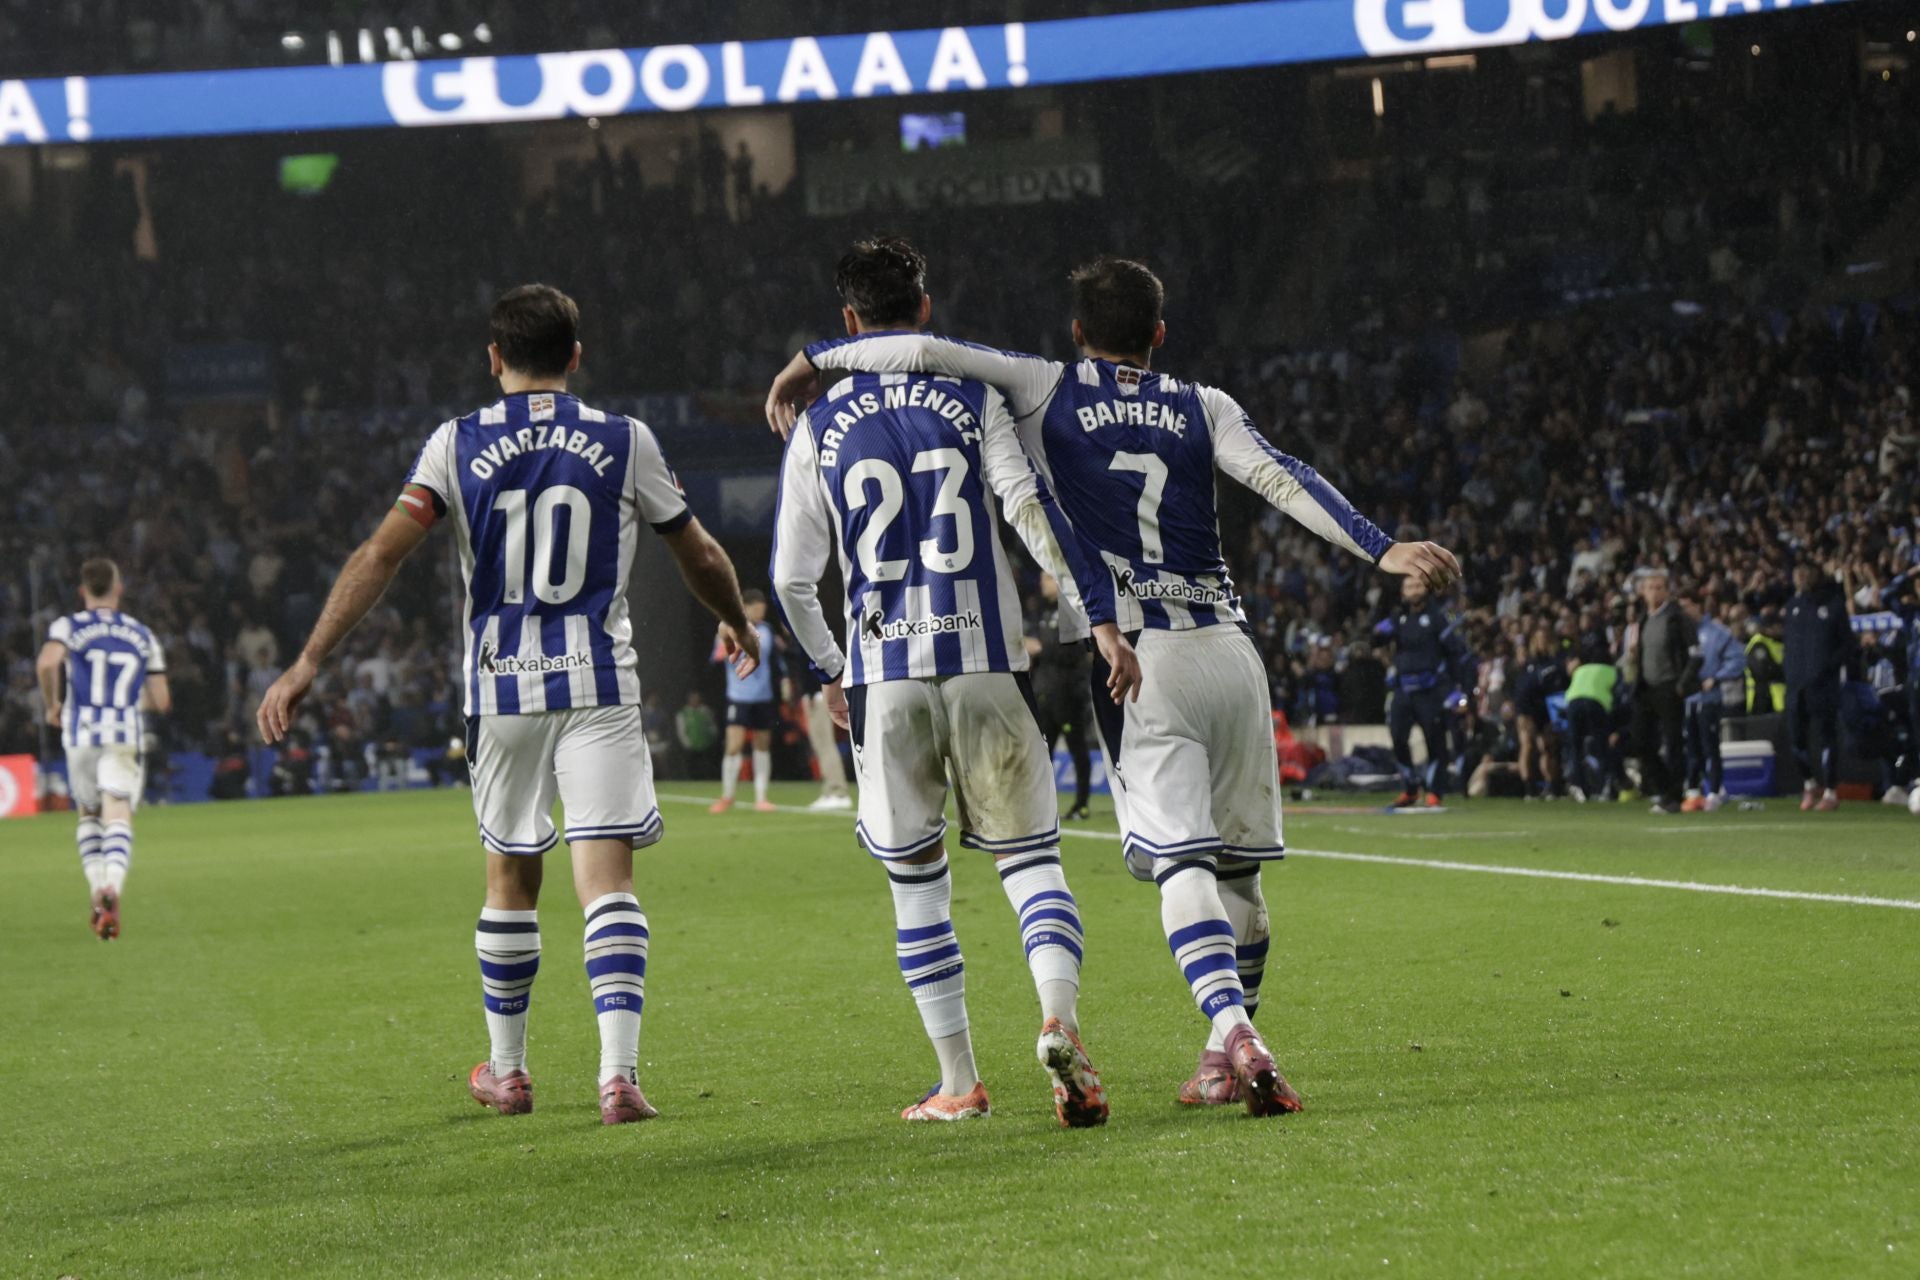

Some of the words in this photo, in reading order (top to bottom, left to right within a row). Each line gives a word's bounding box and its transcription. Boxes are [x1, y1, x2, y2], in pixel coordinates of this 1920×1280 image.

[820, 392, 880, 467] BRAIS
[884, 380, 983, 446] MÉNDEZ
[470, 425, 615, 480] OYARZABAL
[843, 447, 975, 583] 23
[1108, 450, 1169, 564] 7
[492, 484, 592, 605] 10
[1109, 564, 1226, 604] Kutxabank
[861, 605, 981, 641] Kutxabank
[85, 648, 139, 710] 17
[479, 641, 590, 674] Kutxabank
[499, 1000, 524, 1010] RS
[603, 996, 627, 1007] RS
[1209, 993, 1231, 1009] RS
